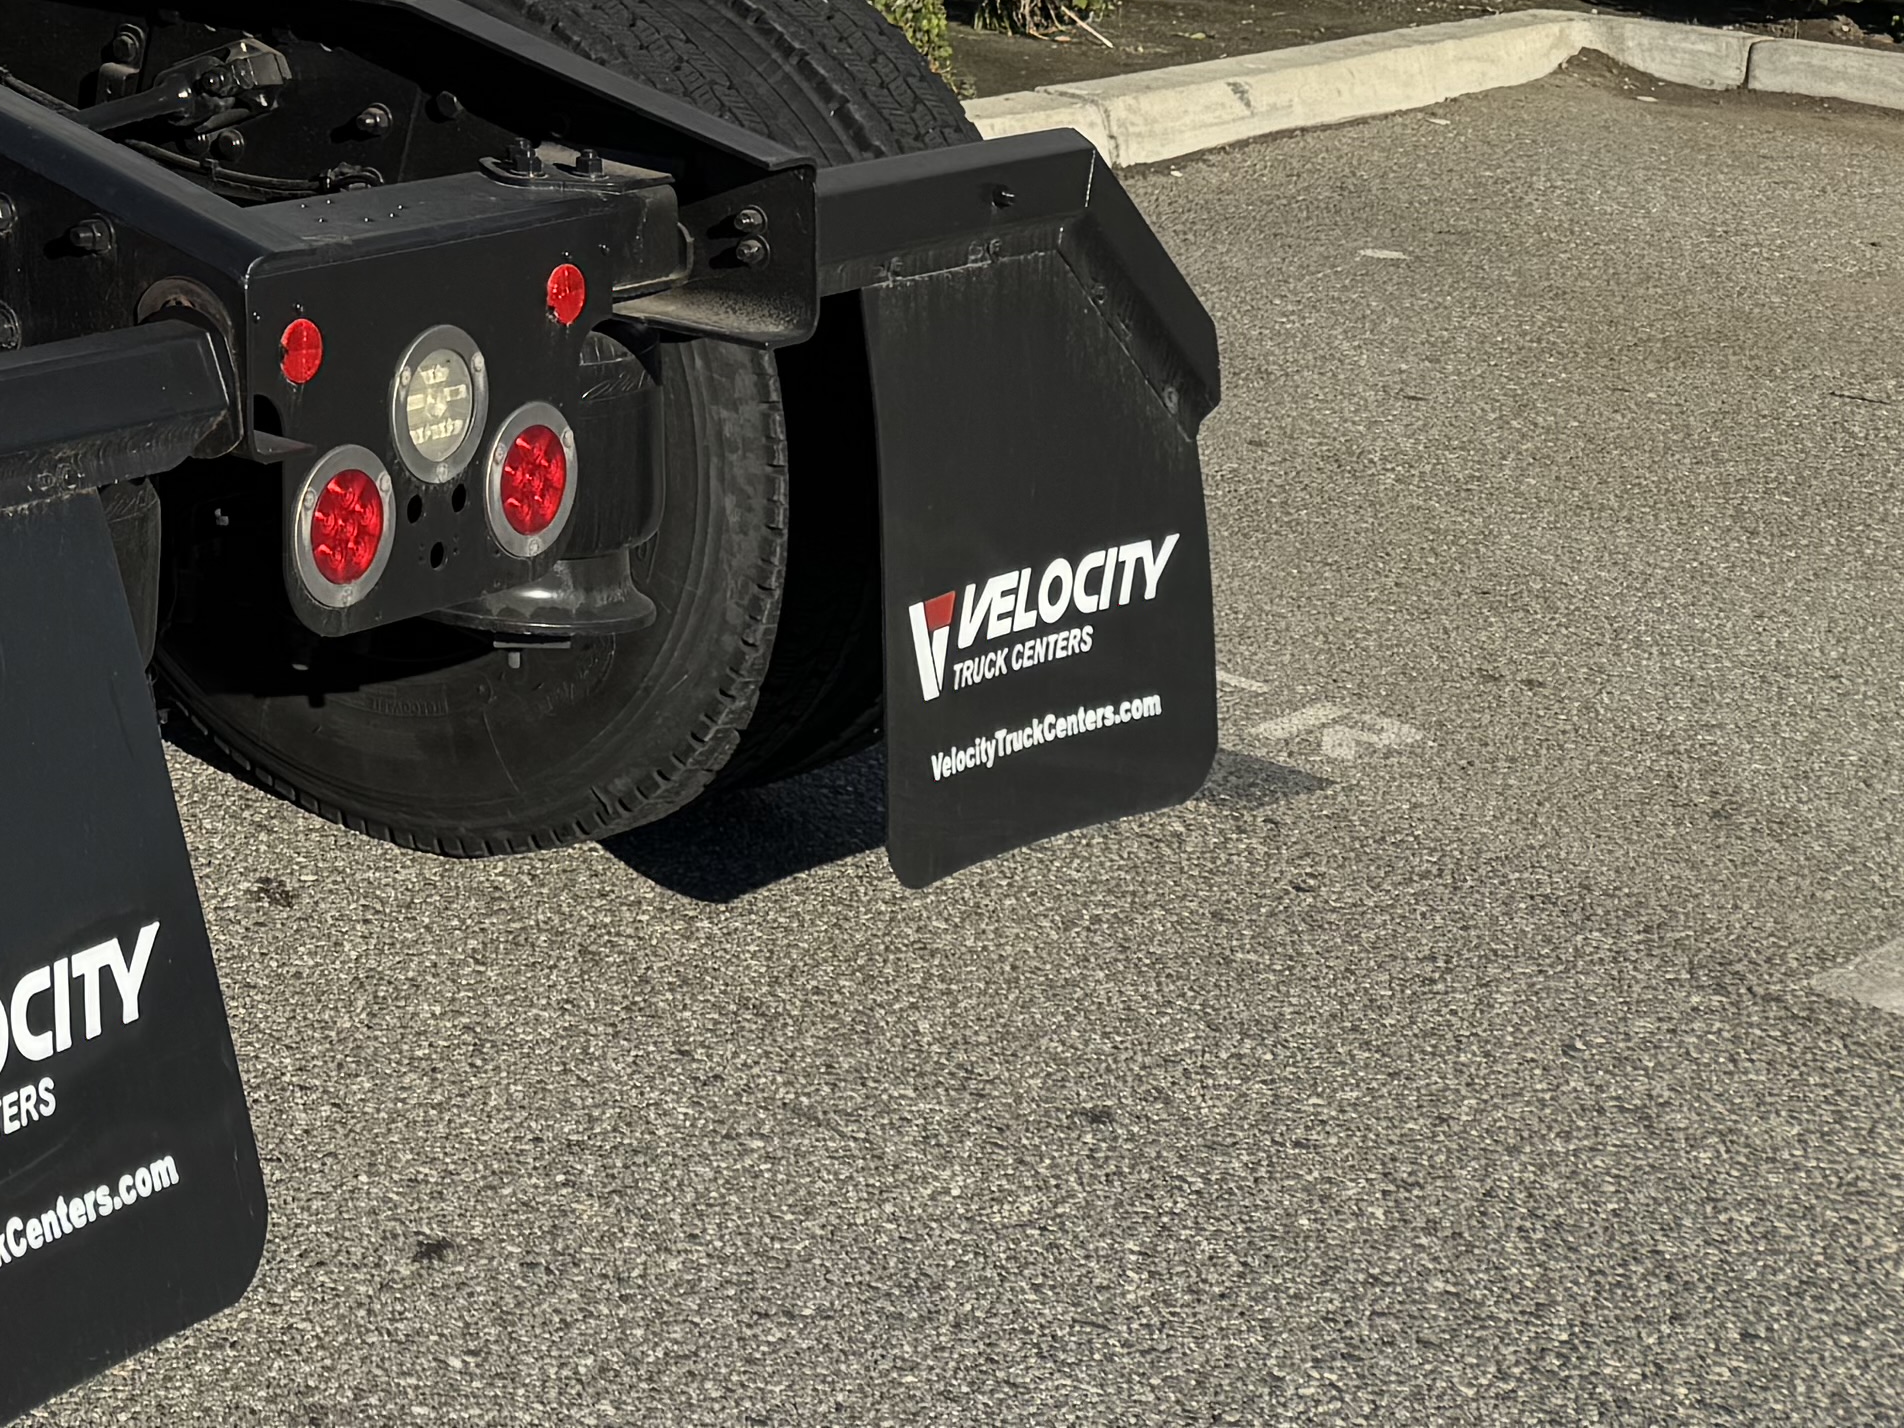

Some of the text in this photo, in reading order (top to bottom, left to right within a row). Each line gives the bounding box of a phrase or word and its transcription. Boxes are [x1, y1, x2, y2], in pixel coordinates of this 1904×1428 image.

[958, 532, 1181, 650] VELOCITY
[953, 624, 1094, 691] TRUCK CENTERS
[930, 694, 1162, 781] VelocityTruckCenters.com
